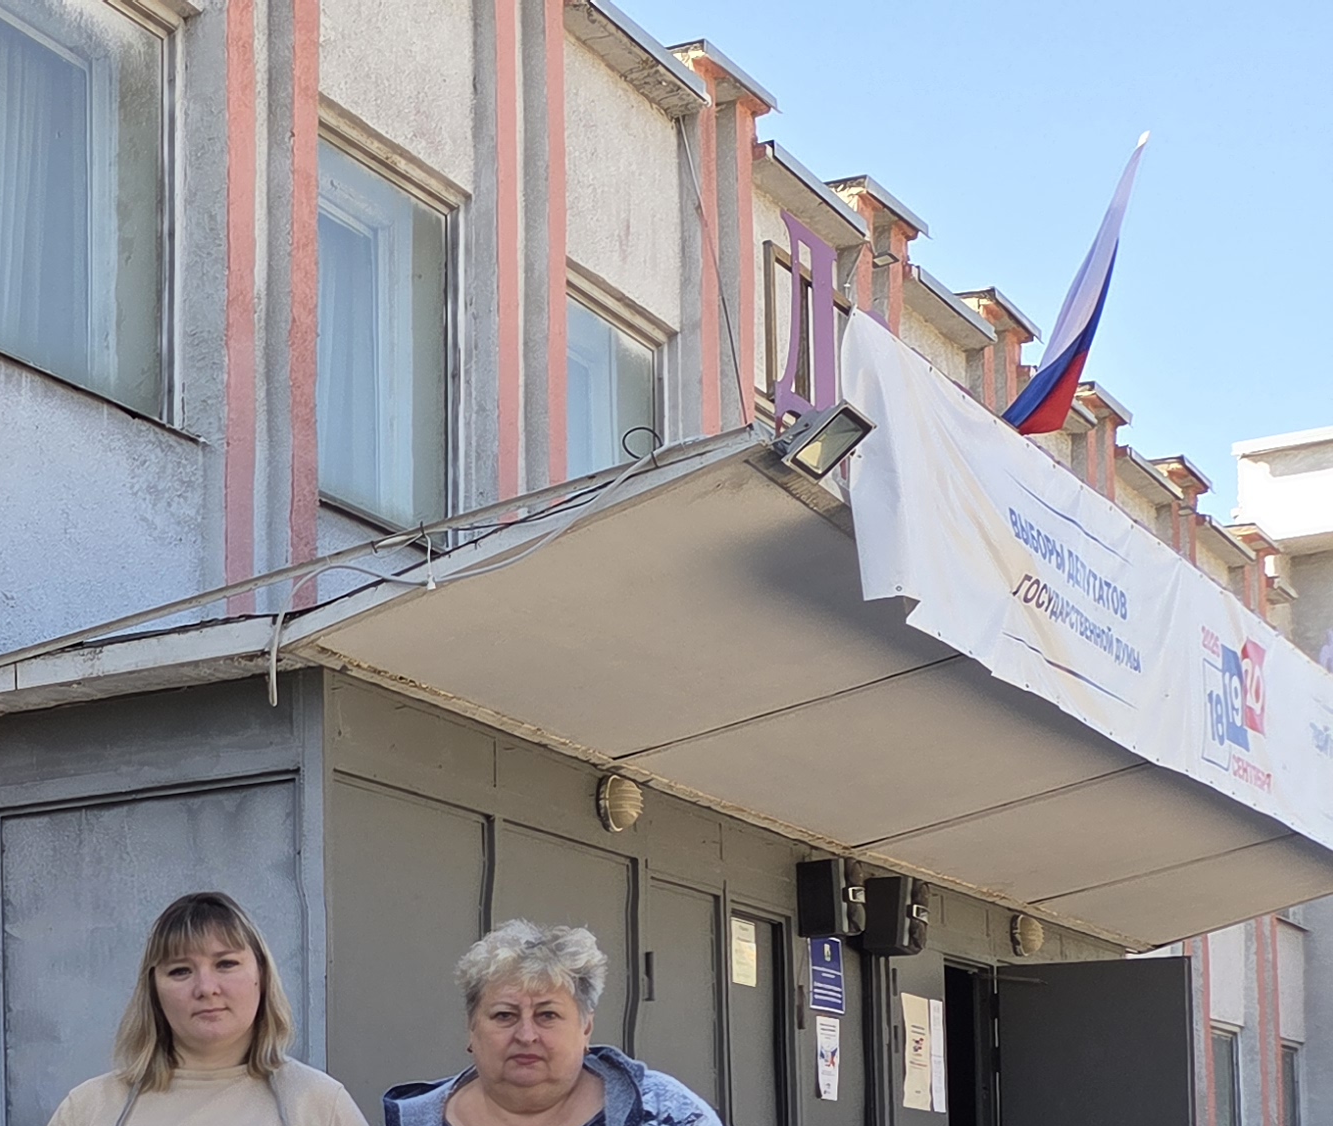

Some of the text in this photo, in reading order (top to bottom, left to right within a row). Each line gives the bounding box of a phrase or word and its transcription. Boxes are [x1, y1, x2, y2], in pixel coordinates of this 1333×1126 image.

[1008, 507, 1066, 575] ВЫБОРЫ
[1207, 658, 1264, 747] 18 19 20
